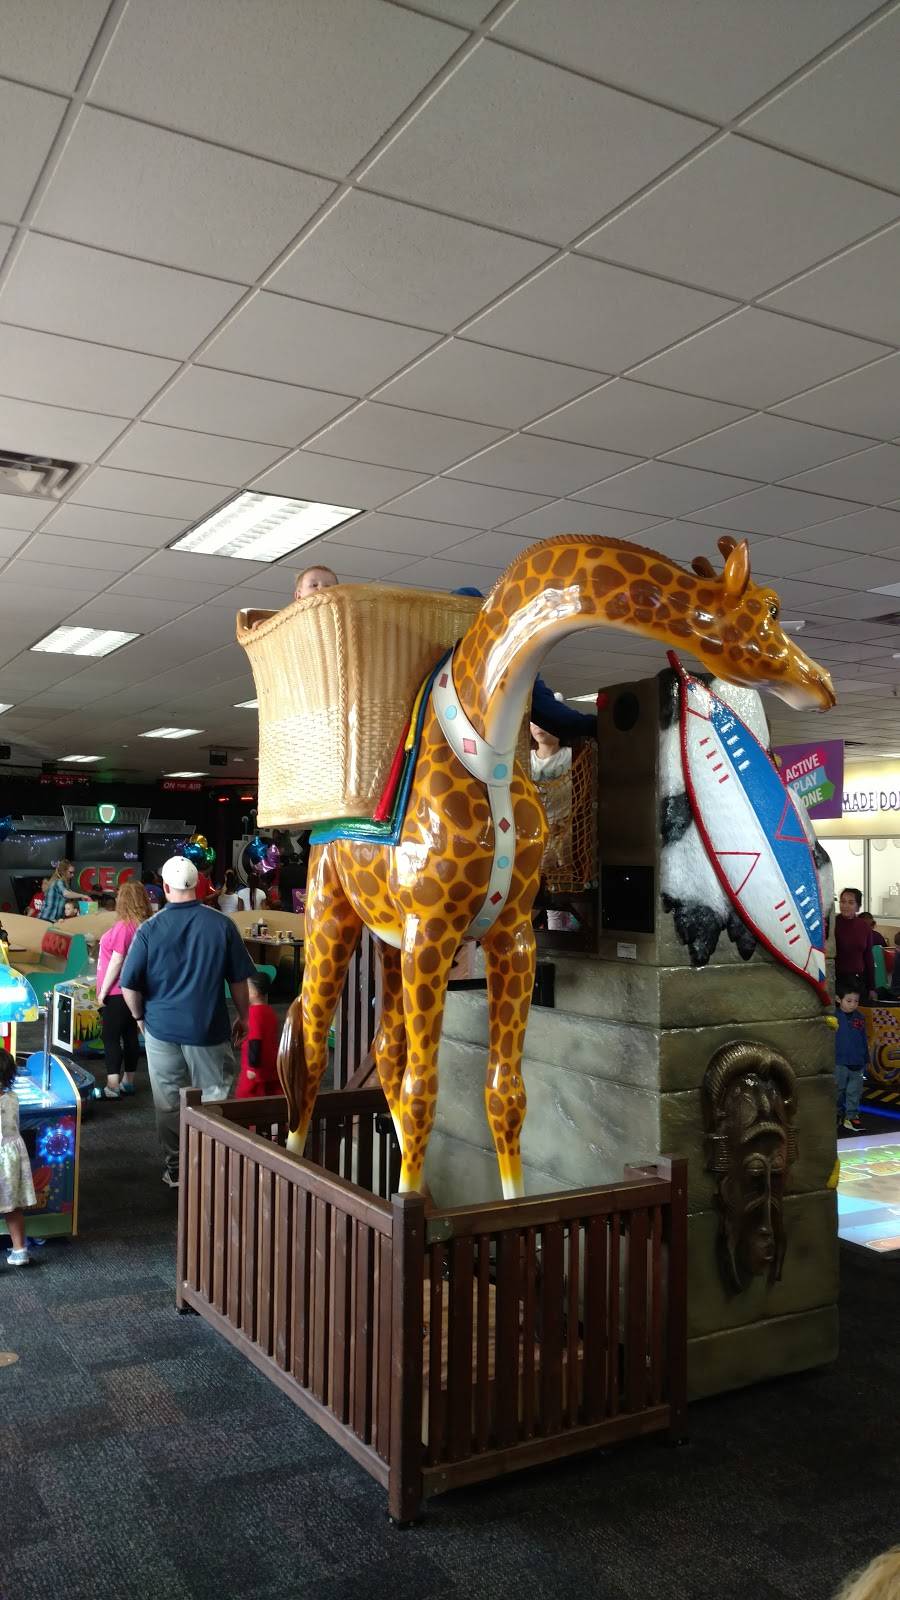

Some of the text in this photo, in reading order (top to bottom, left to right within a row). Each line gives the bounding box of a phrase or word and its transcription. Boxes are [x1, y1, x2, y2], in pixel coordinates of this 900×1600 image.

[785, 753, 821, 782] ACTIVE
[163, 782, 176, 790] ON
[793, 771, 818, 793] PLAY
[800, 788, 824, 809] ONE
[880, 791, 900, 809] DO
[78, 866, 136, 893] CEC
